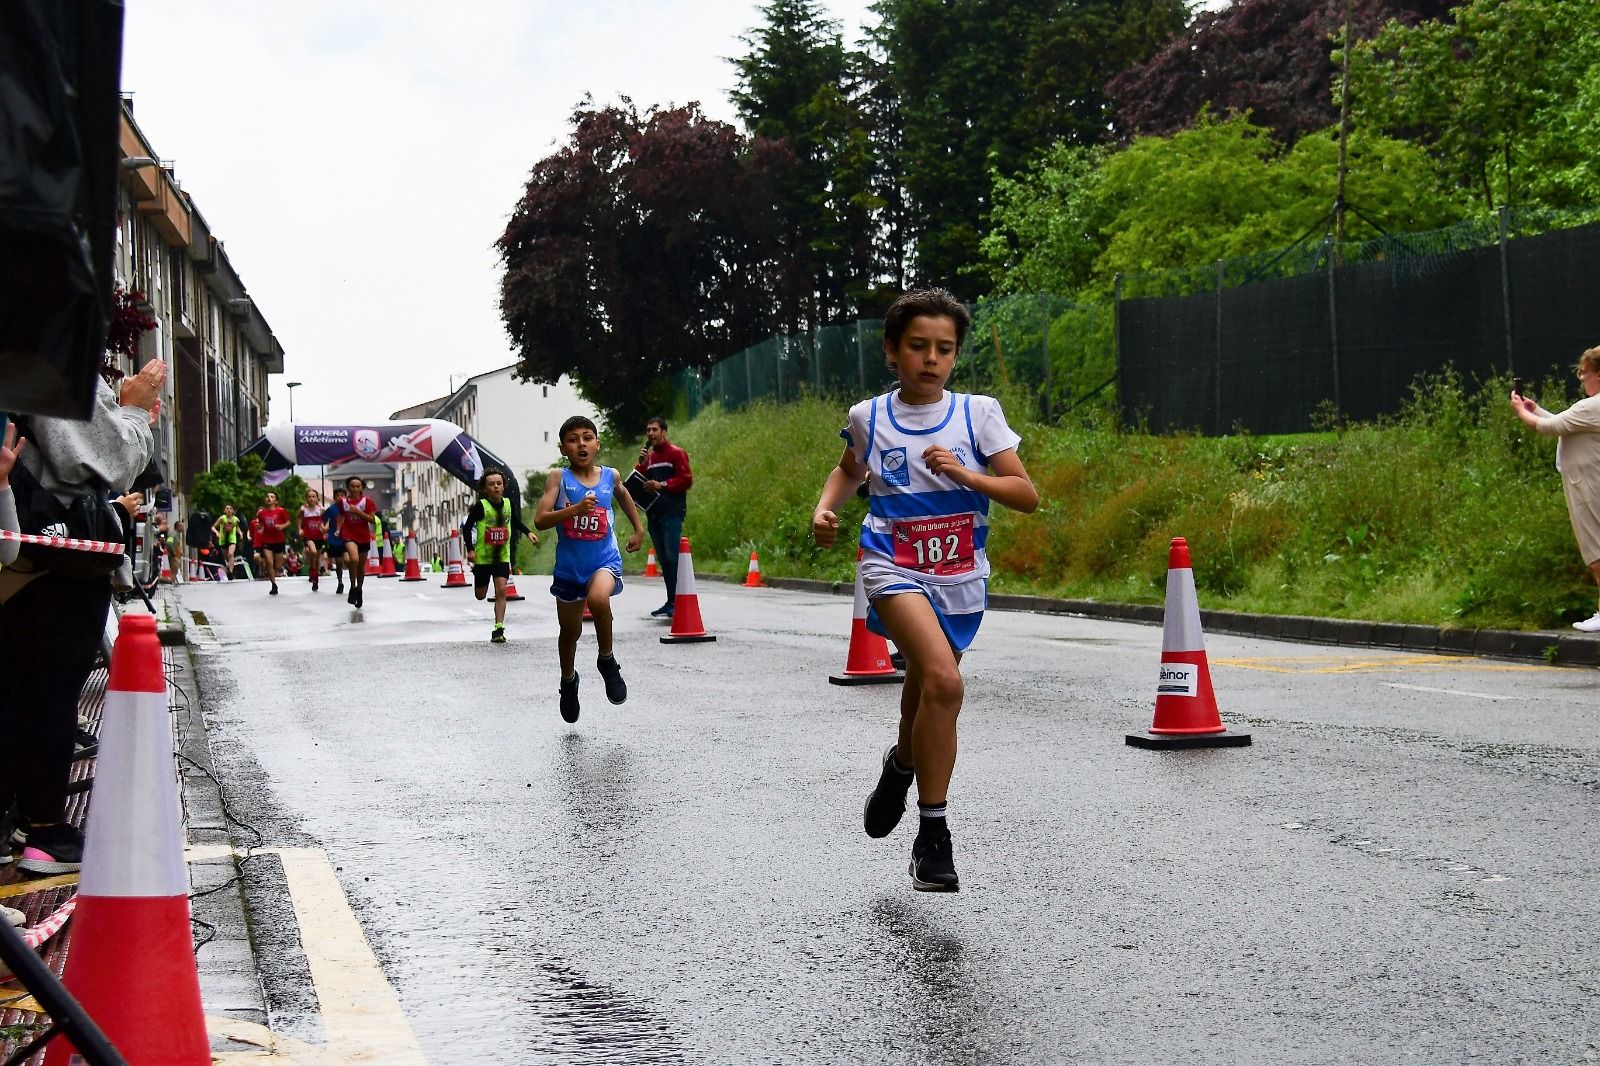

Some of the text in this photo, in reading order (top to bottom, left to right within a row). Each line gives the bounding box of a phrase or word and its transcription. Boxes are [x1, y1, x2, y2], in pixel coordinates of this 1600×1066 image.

[300, 436, 348, 444] Atletismo
[573, 515, 599, 531] 195
[911, 524, 926, 532] Milla
[927, 522, 949, 531] Urbana
[490, 532, 504, 540] 183
[912, 534, 959, 565] 182
